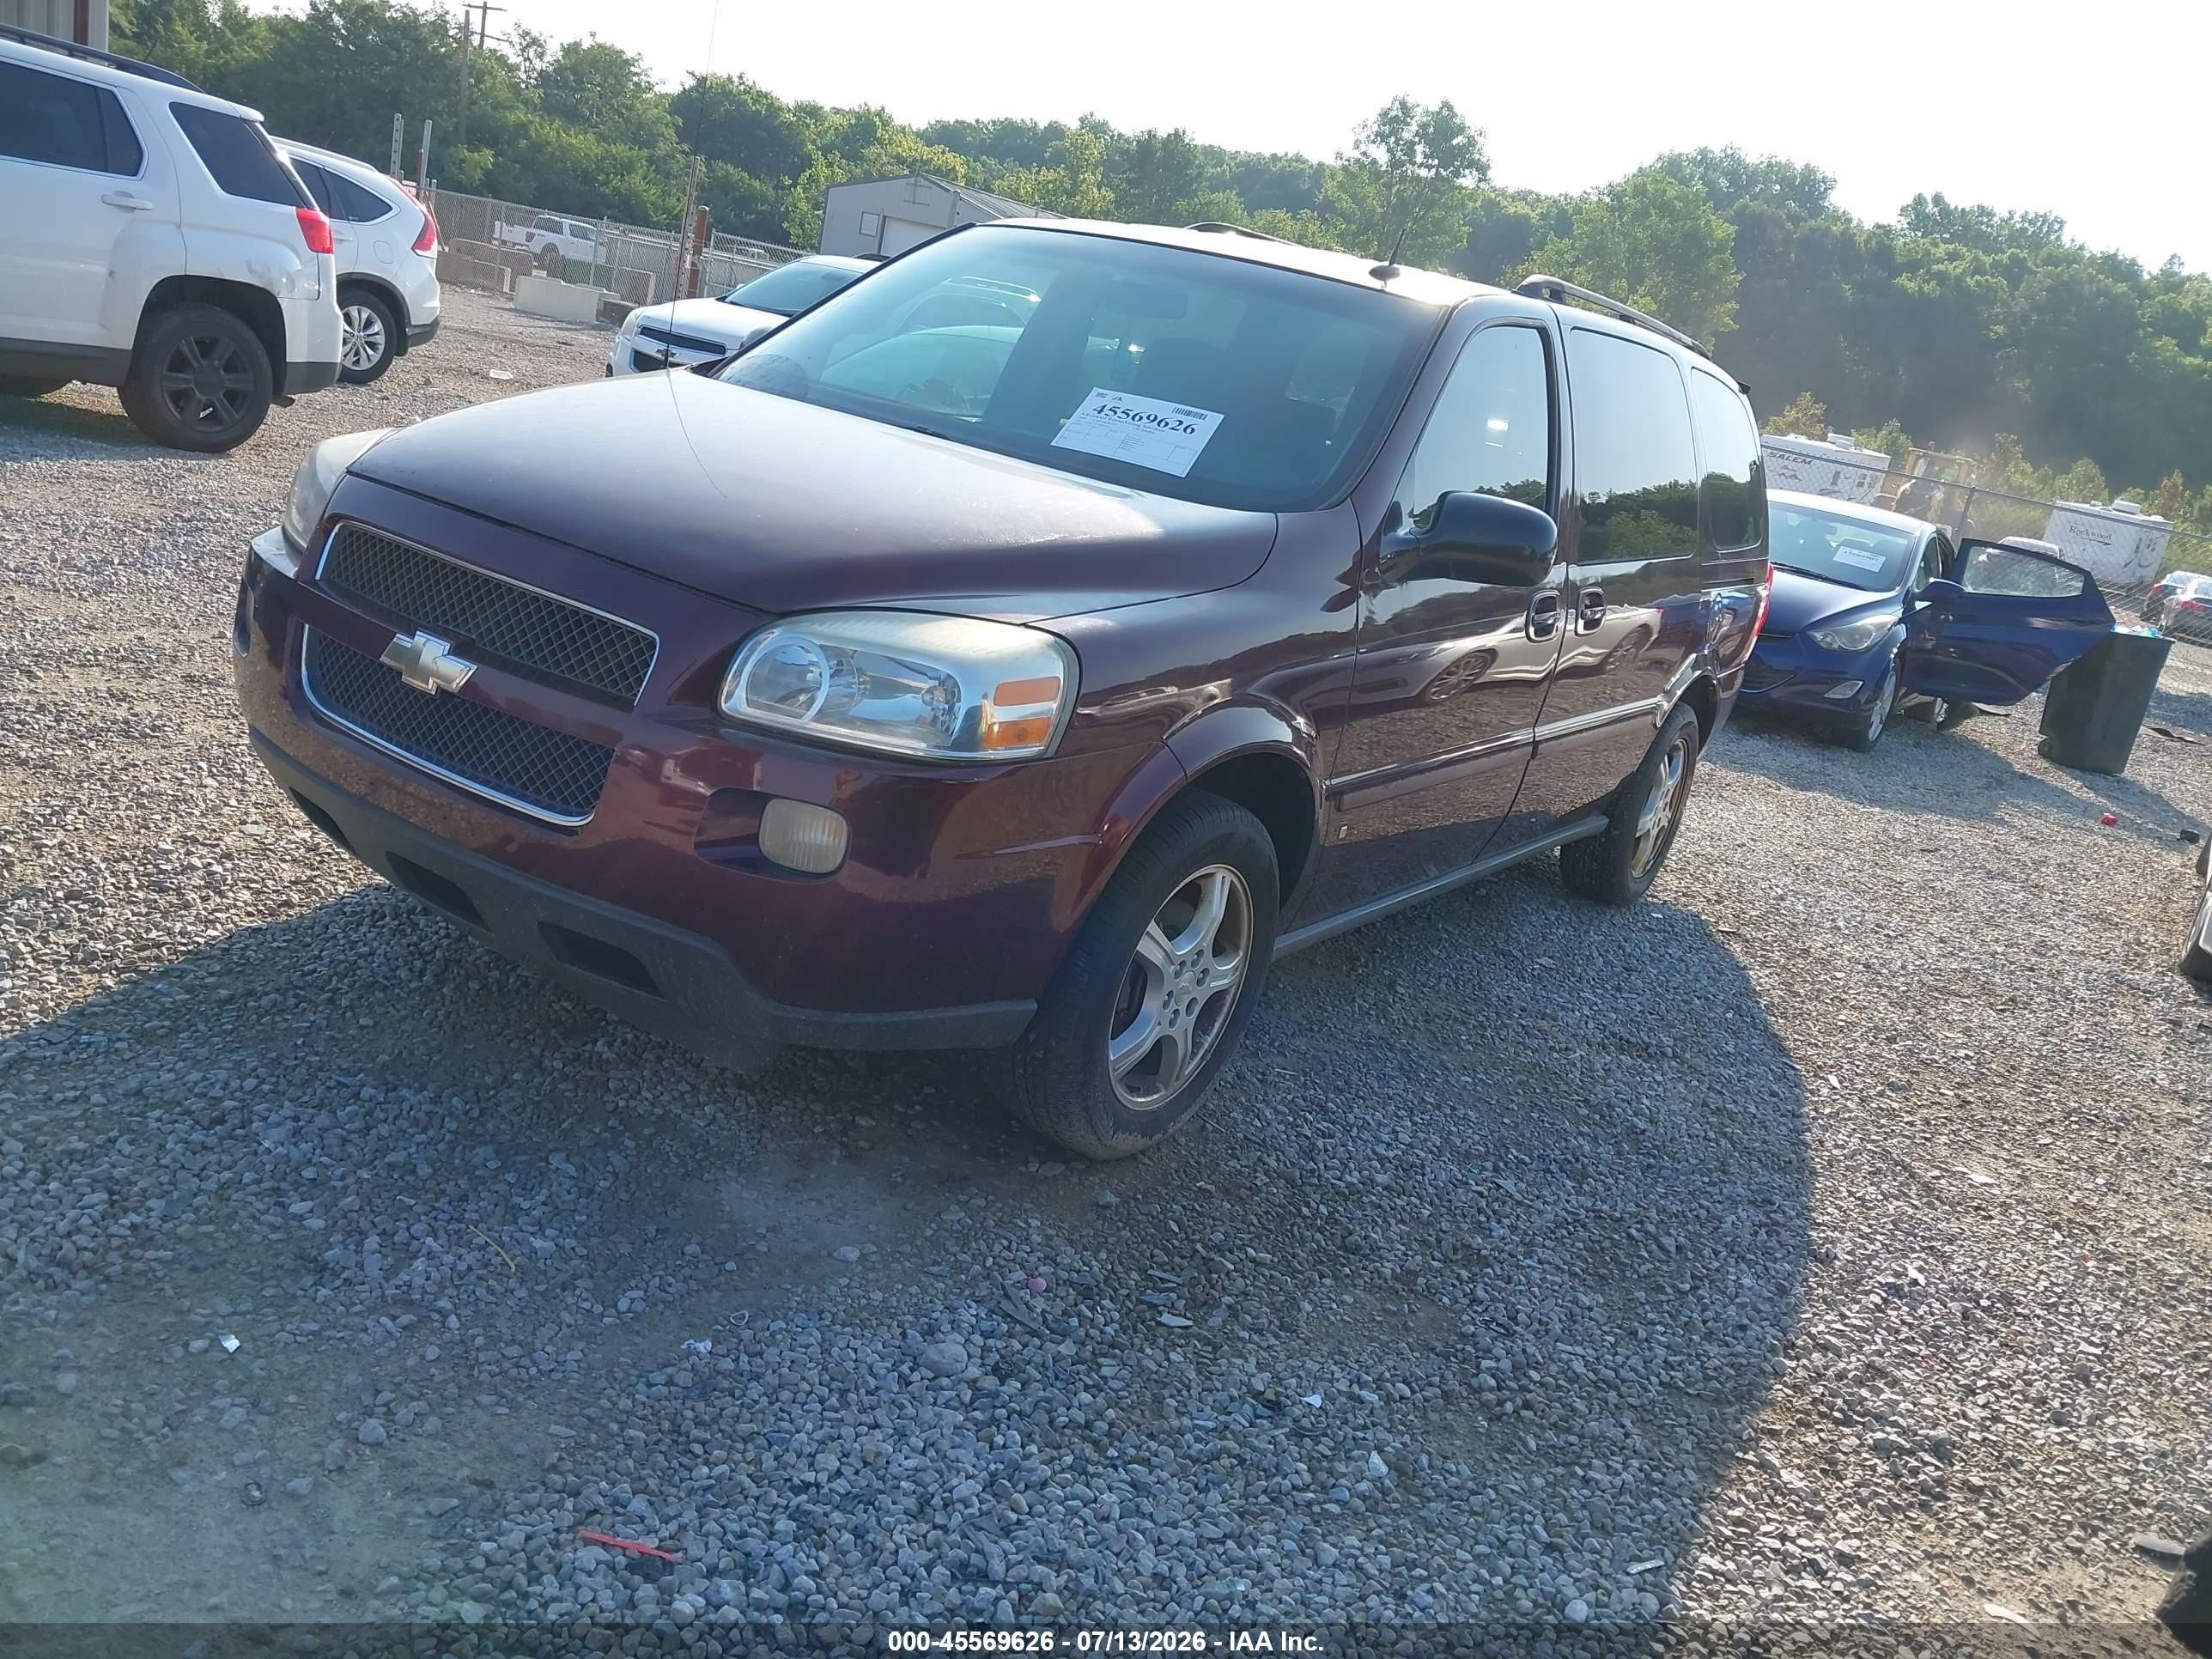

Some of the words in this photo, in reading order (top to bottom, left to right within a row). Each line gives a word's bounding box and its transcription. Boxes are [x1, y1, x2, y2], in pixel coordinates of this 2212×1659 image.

[1092, 404, 1200, 434] 45569626
[1767, 452, 1814, 465] SALEM
[2069, 525, 2112, 540] Rockwood
